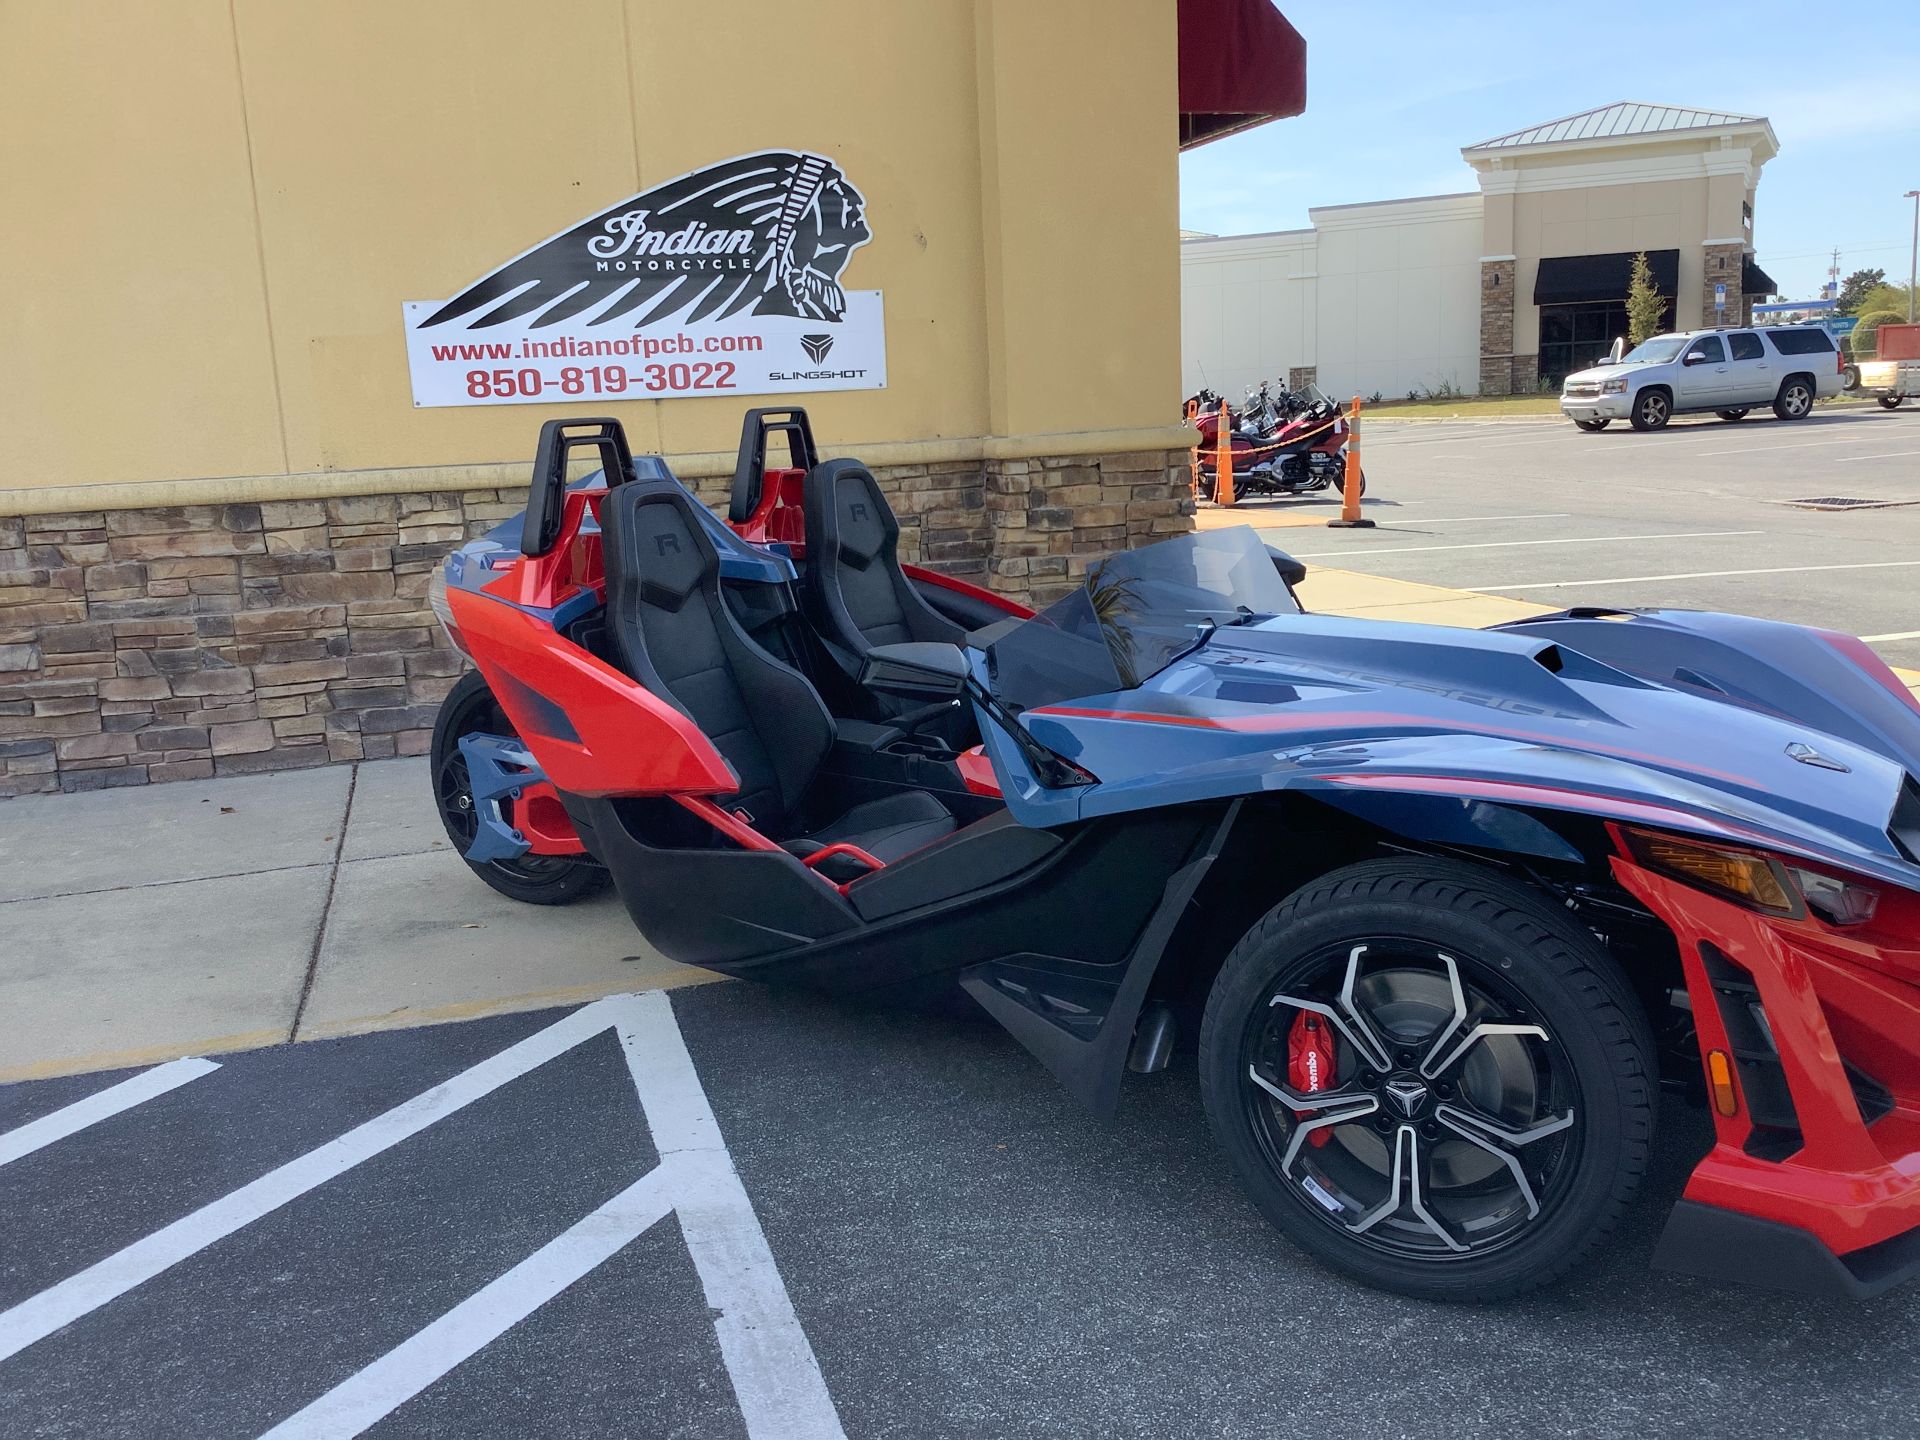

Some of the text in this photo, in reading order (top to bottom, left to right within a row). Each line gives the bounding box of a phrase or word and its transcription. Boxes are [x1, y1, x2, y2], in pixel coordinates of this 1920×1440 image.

[587, 210, 755, 259] Indian
[596, 258, 752, 272] MOTORCYCLE
[431, 333, 763, 361] www.indianofpcb.com
[466, 361, 737, 398] 850-819-3022
[768, 369, 868, 381] SLINGSHOT
[653, 532, 682, 557] R
